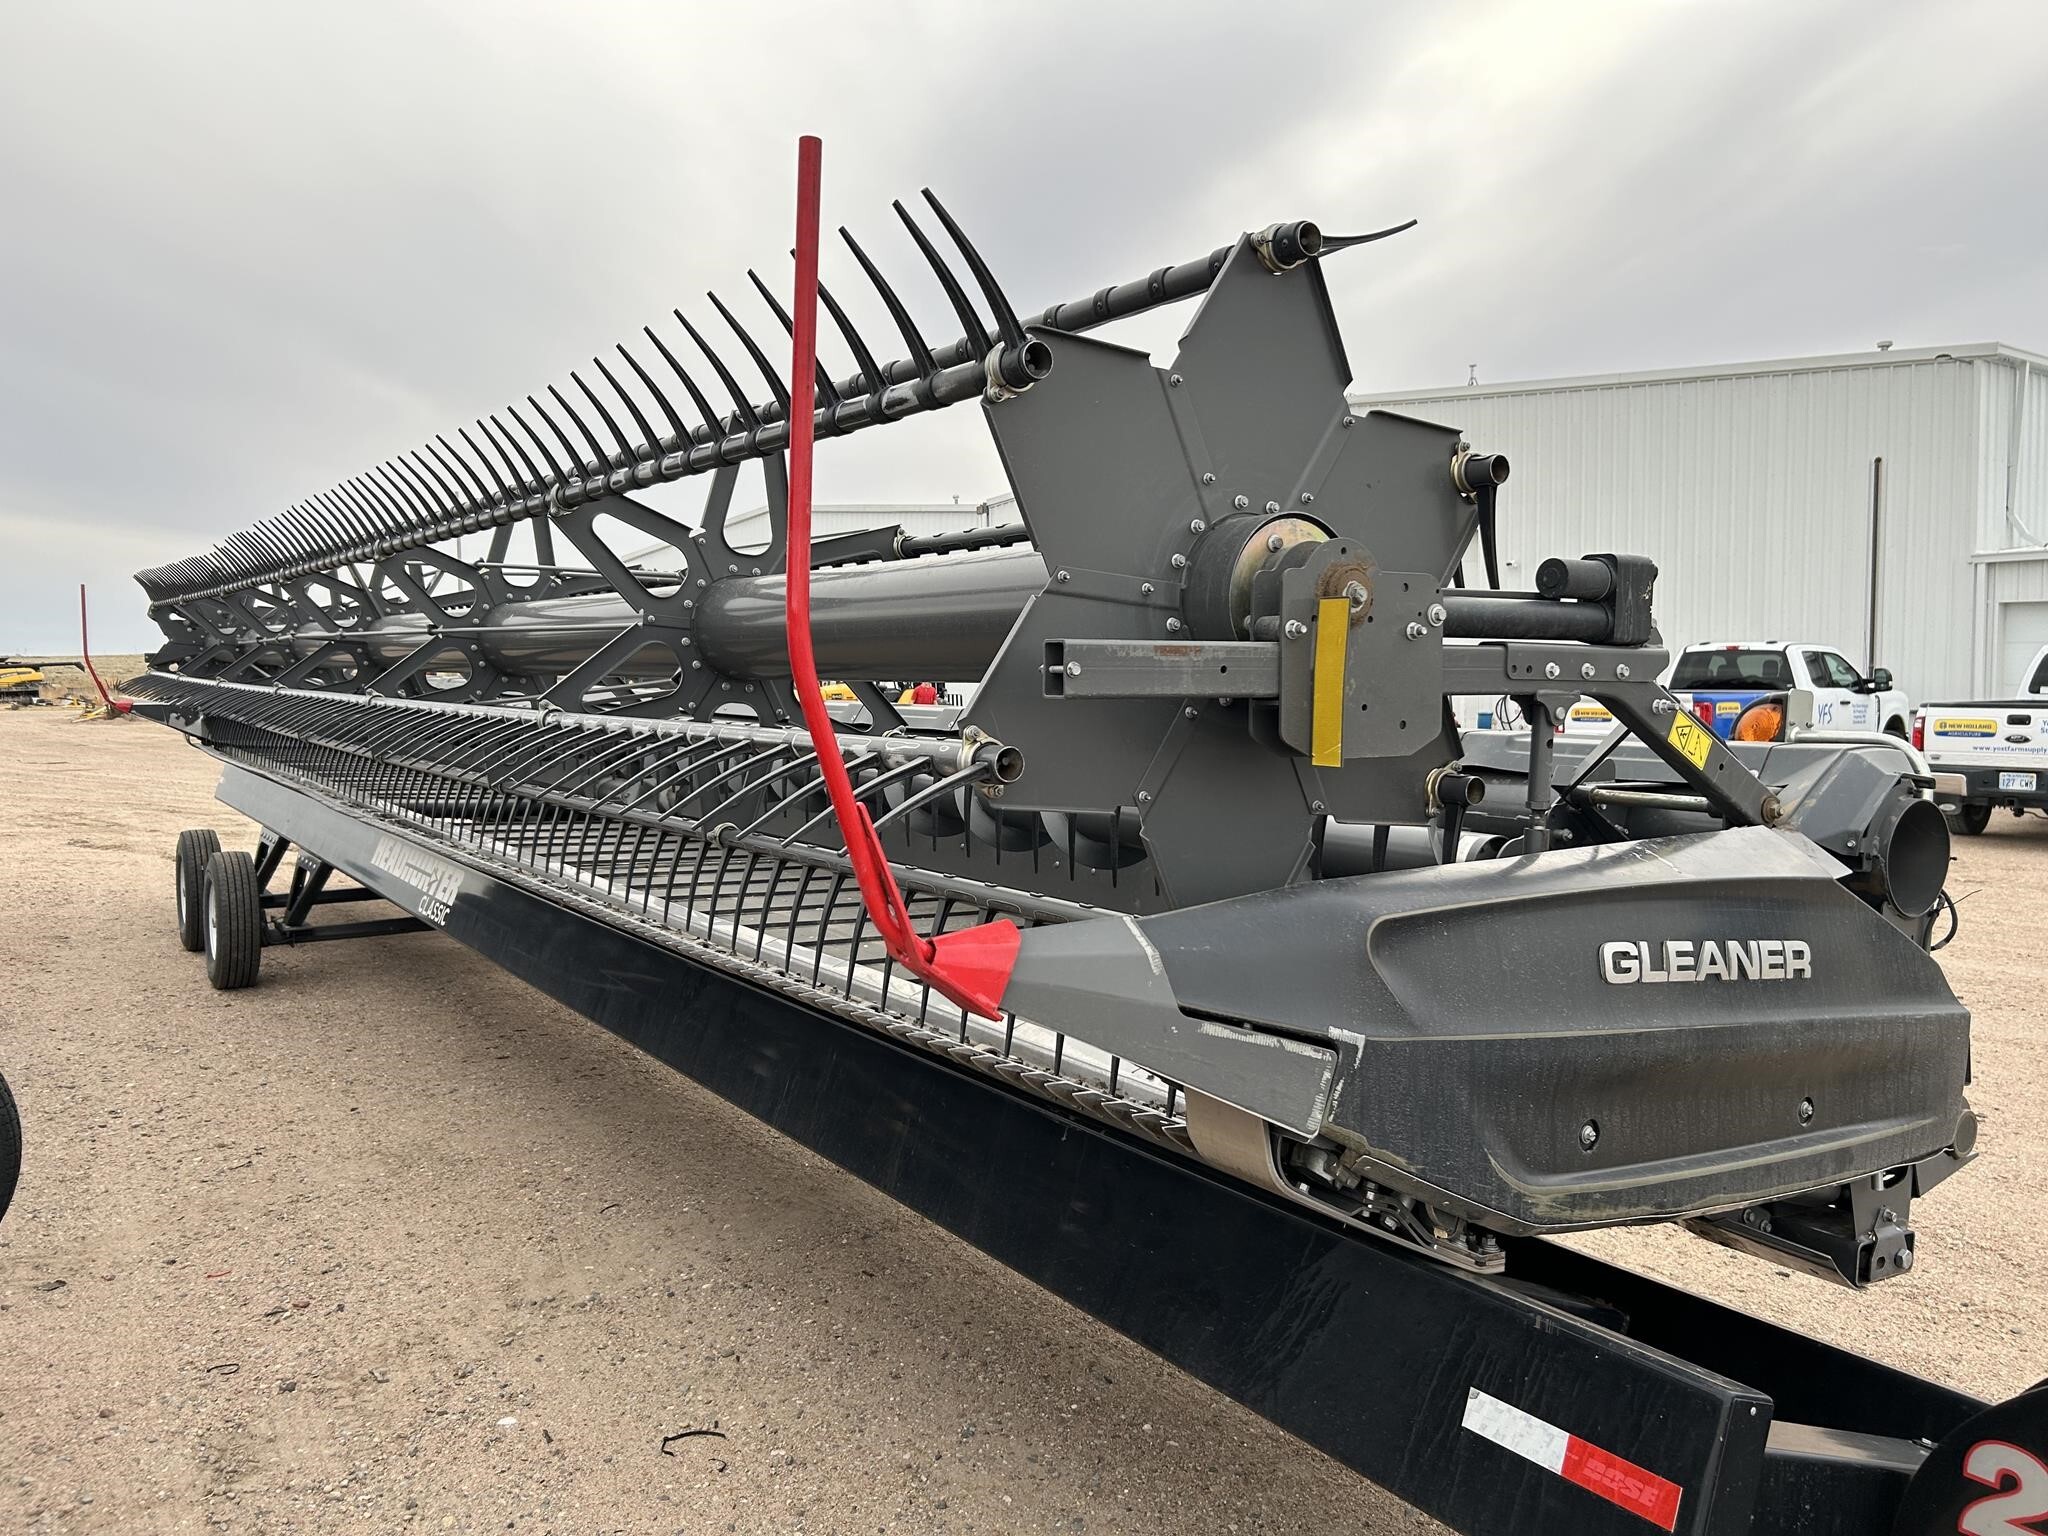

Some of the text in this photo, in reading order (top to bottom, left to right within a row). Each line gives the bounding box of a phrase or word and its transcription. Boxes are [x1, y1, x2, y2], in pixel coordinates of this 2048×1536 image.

[1818, 703, 1833, 725] YFS
[418, 895, 451, 926] CLASSIC
[1600, 939, 1812, 984] GLEANER
[1958, 1440, 2048, 1536] 2
